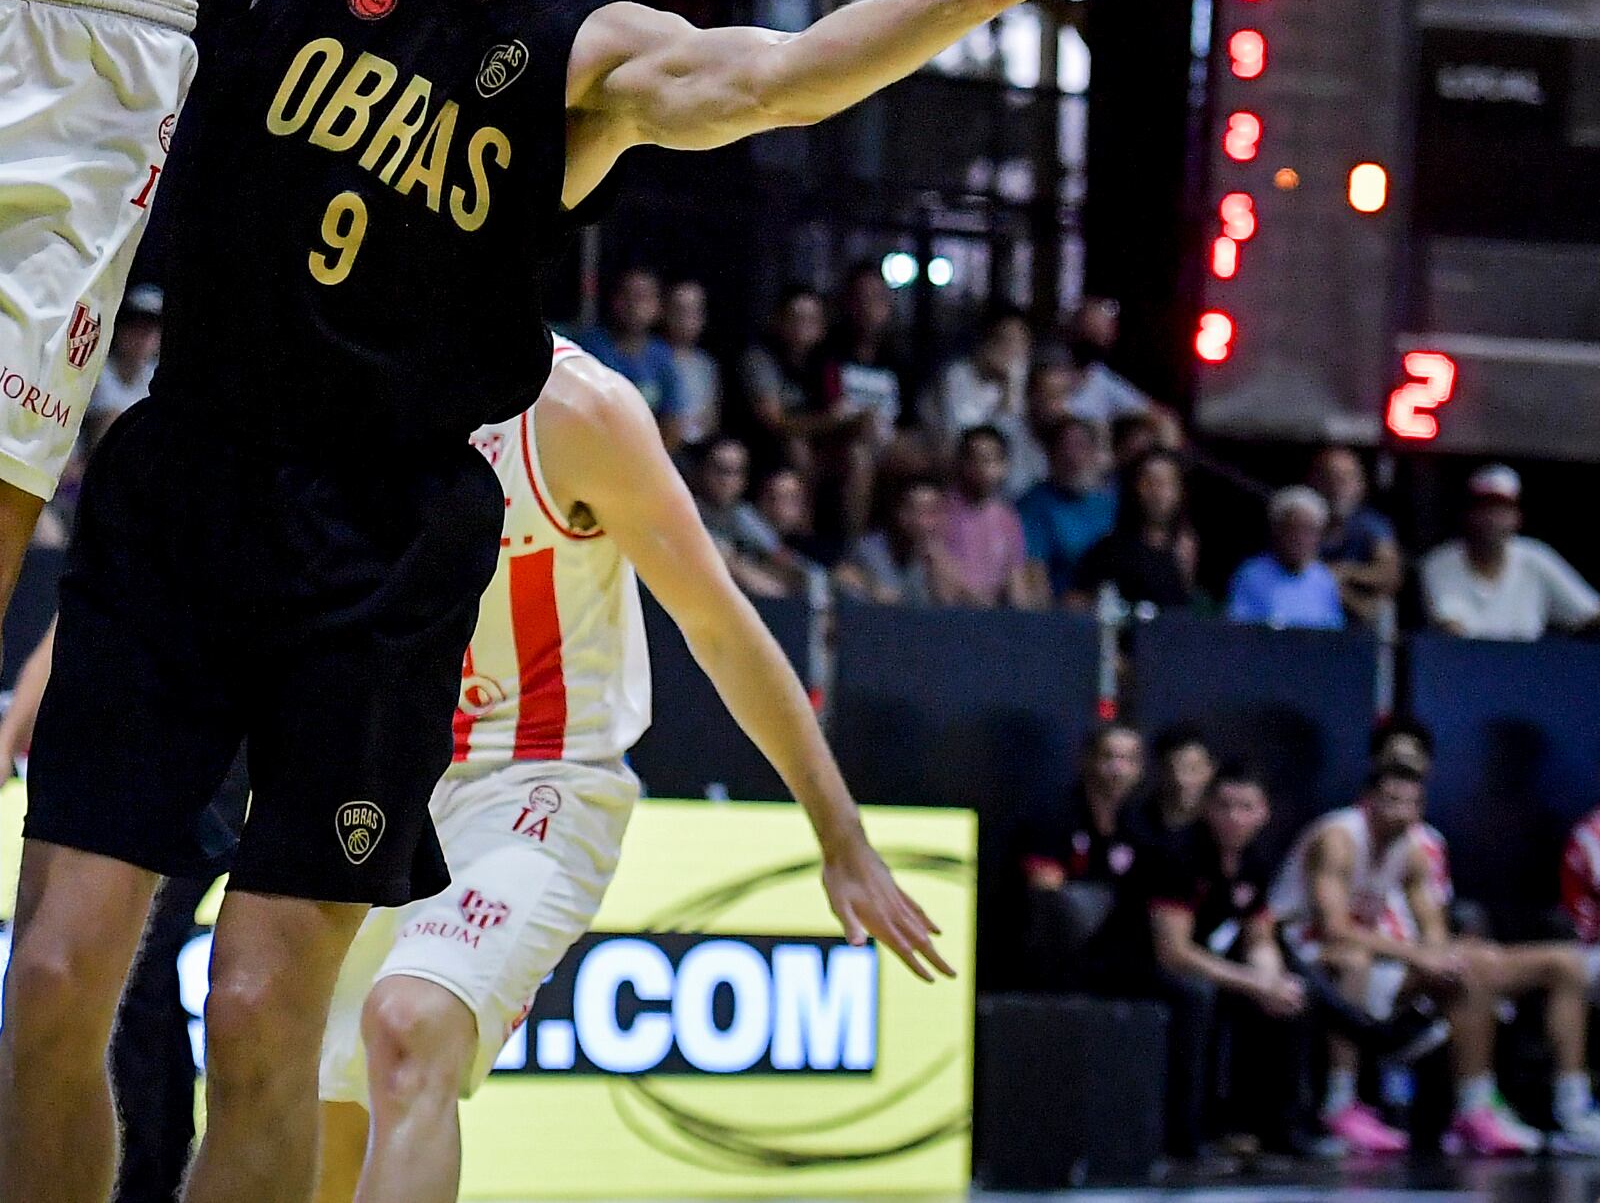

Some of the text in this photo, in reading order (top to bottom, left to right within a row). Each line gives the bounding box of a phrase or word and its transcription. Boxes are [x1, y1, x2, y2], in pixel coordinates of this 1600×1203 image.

[266, 37, 513, 232] OBRAS
[307, 190, 369, 286] 9
[1387, 351, 1456, 439] 2
[343, 807, 379, 830] OBRAS
